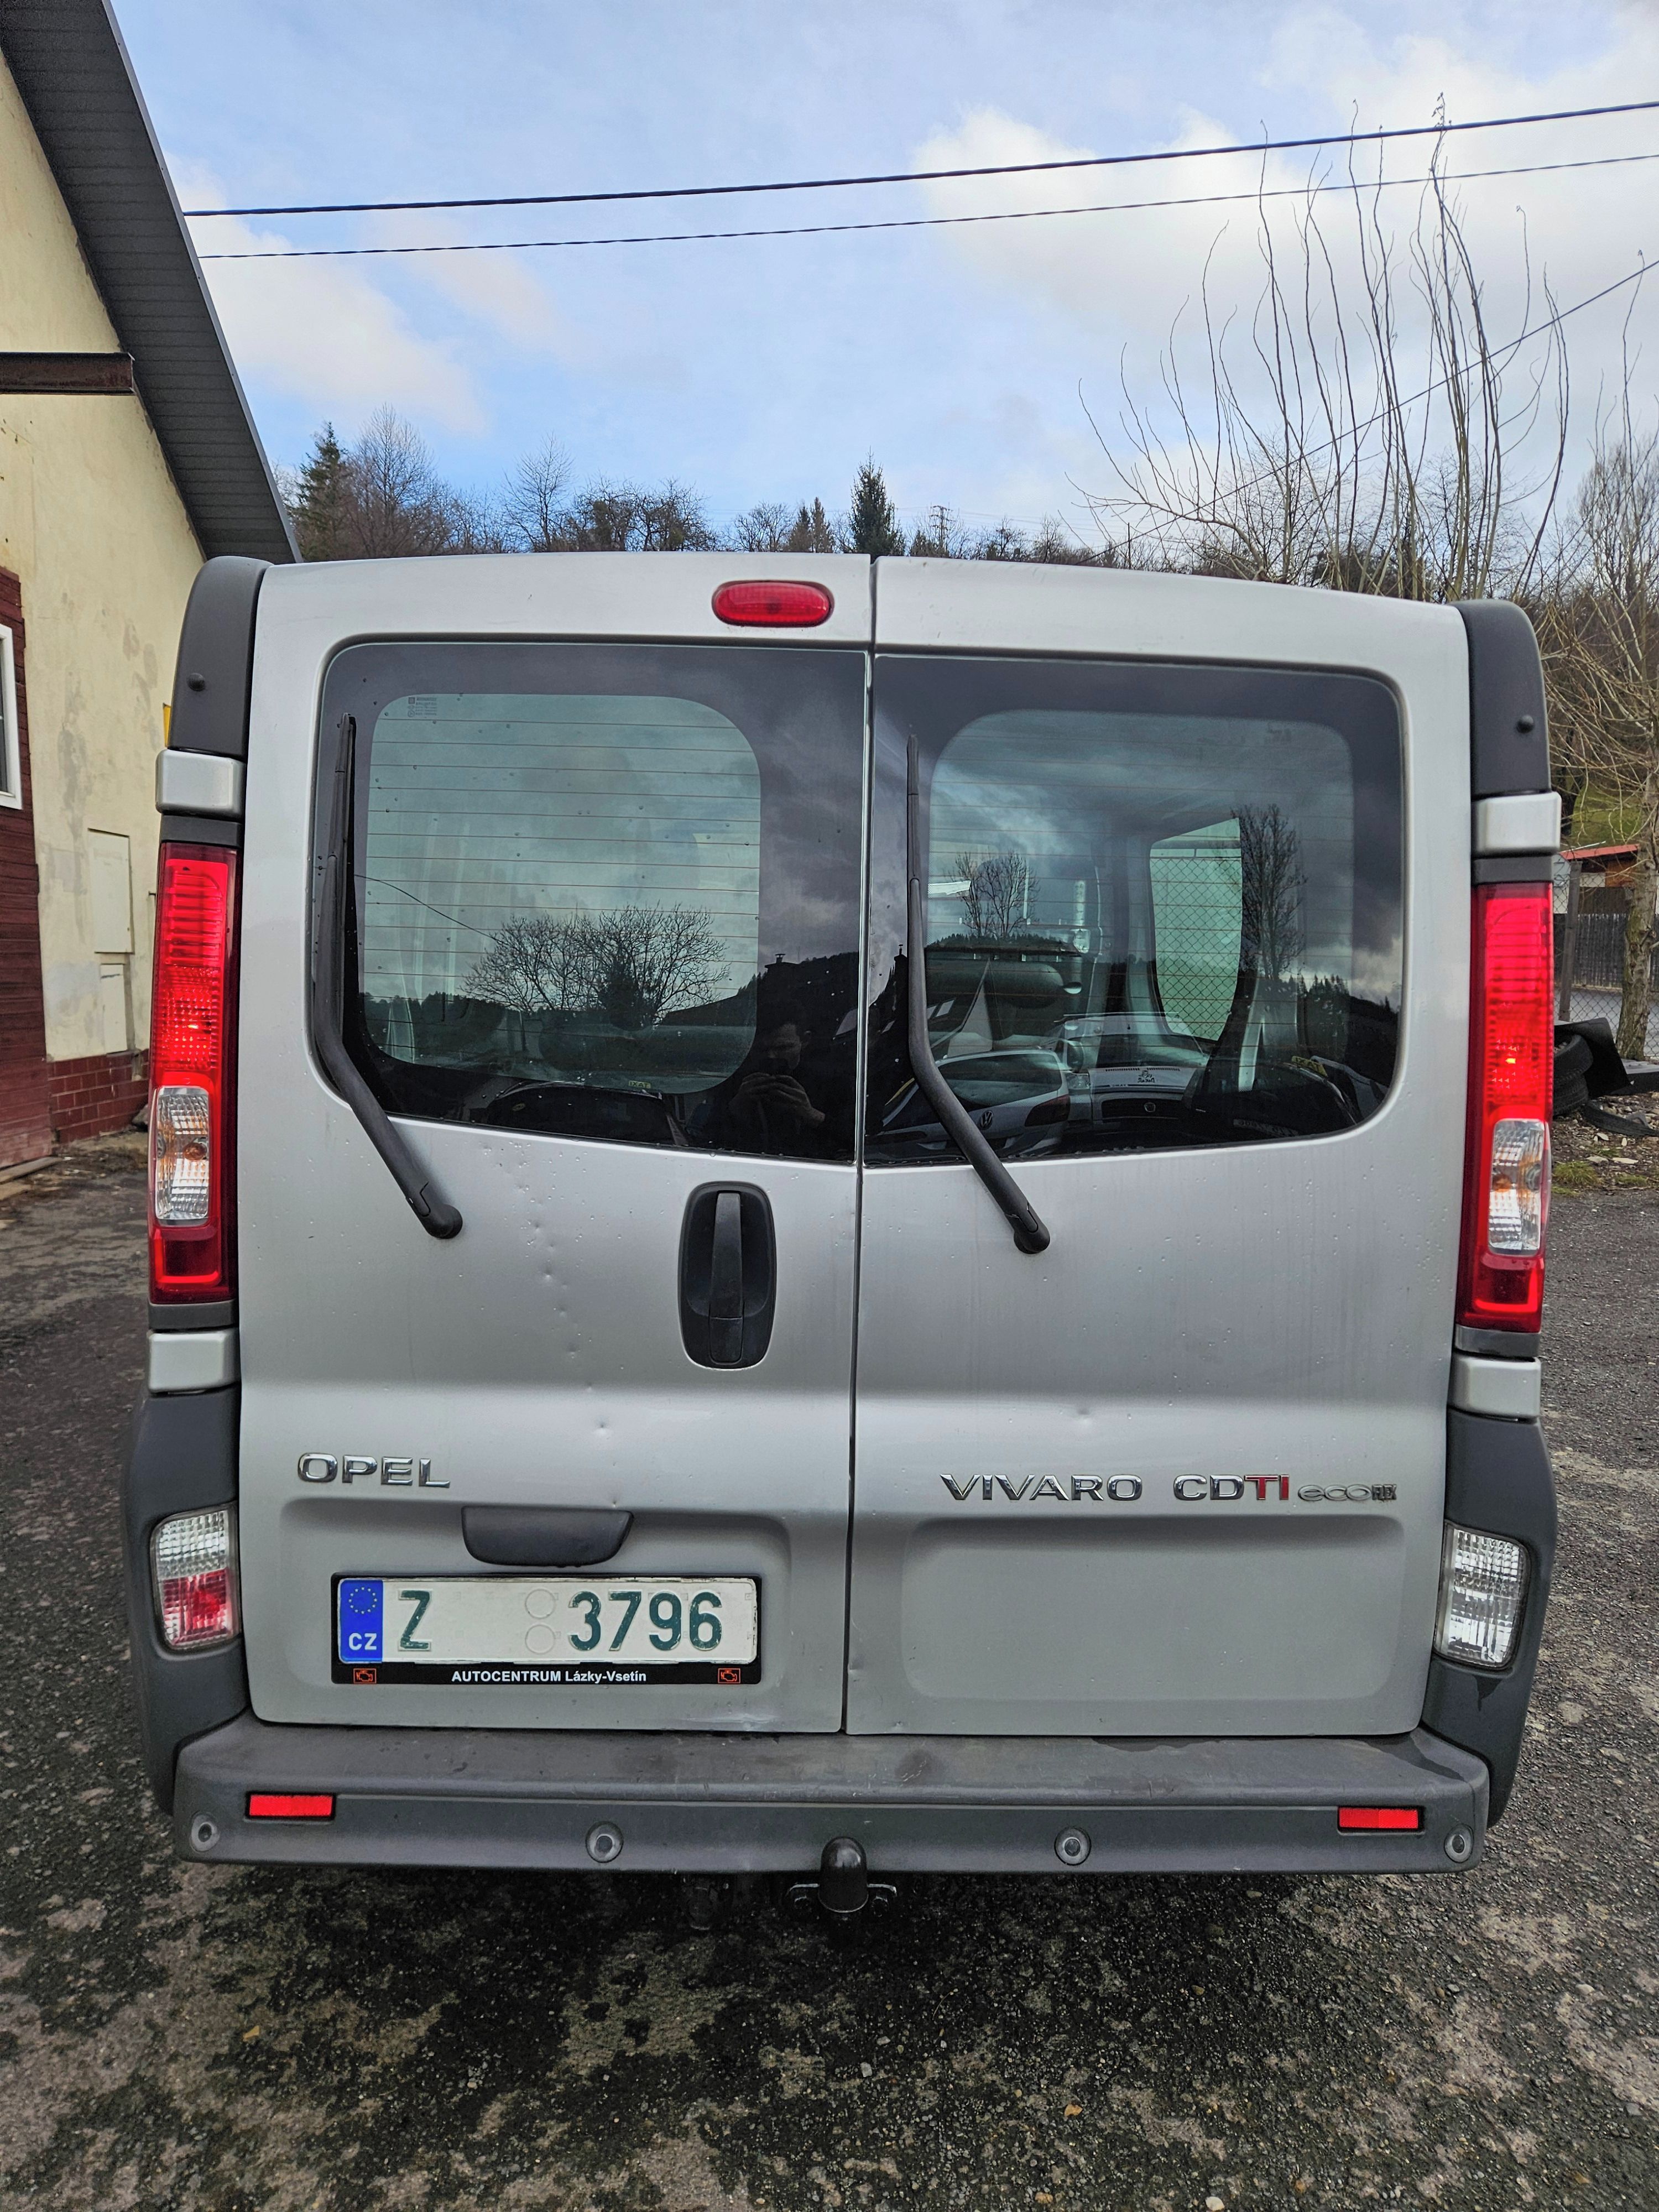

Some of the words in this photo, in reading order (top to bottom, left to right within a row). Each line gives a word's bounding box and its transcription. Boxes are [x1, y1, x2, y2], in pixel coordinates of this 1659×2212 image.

[298, 1452, 450, 1488] OPEL
[940, 1474, 1142, 1501] VIVARO
[1173, 1474, 1290, 1500] CDTI
[398, 1589, 432, 1652] Z
[568, 1590, 722, 1651] 3796
[348, 1632, 377, 1651] CZ
[451, 1670, 561, 1682] AUTOCENTRUM
[565, 1670, 646, 1684] Lázky-Vsetín
